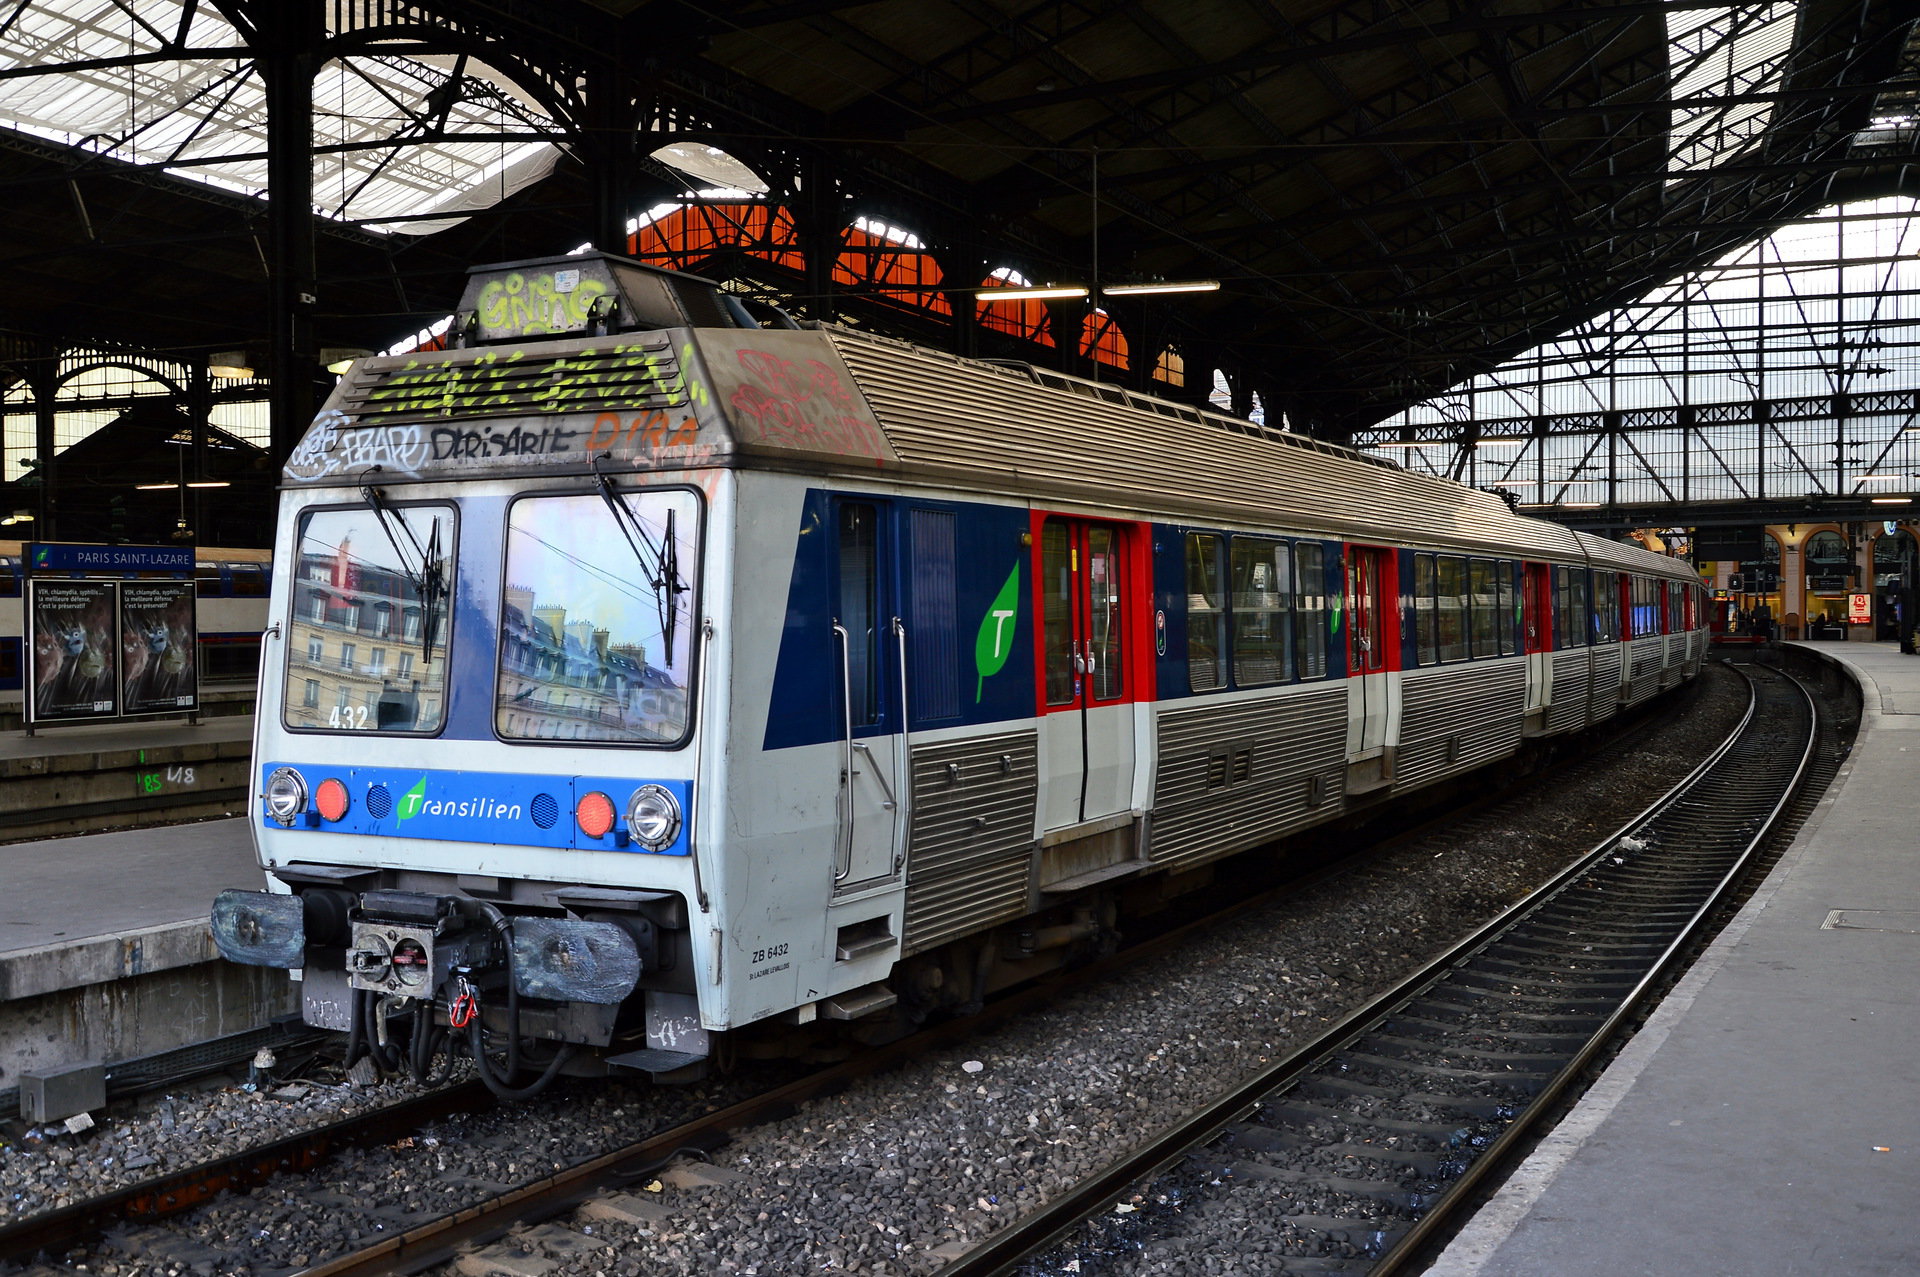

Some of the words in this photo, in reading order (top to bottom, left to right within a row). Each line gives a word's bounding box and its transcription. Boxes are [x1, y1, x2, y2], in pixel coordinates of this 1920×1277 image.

[77, 552, 110, 563] PARIS
[114, 553, 190, 565] SAINT-LAZARE
[143, 602, 168, 610] préservatif
[992, 609, 1014, 659] T
[328, 705, 369, 729] 432
[407, 793, 521, 820] Transilien
[752, 949, 765, 964] ZB
[767, 943, 789, 959] 6432
[754, 967, 770, 979] LAZARE
